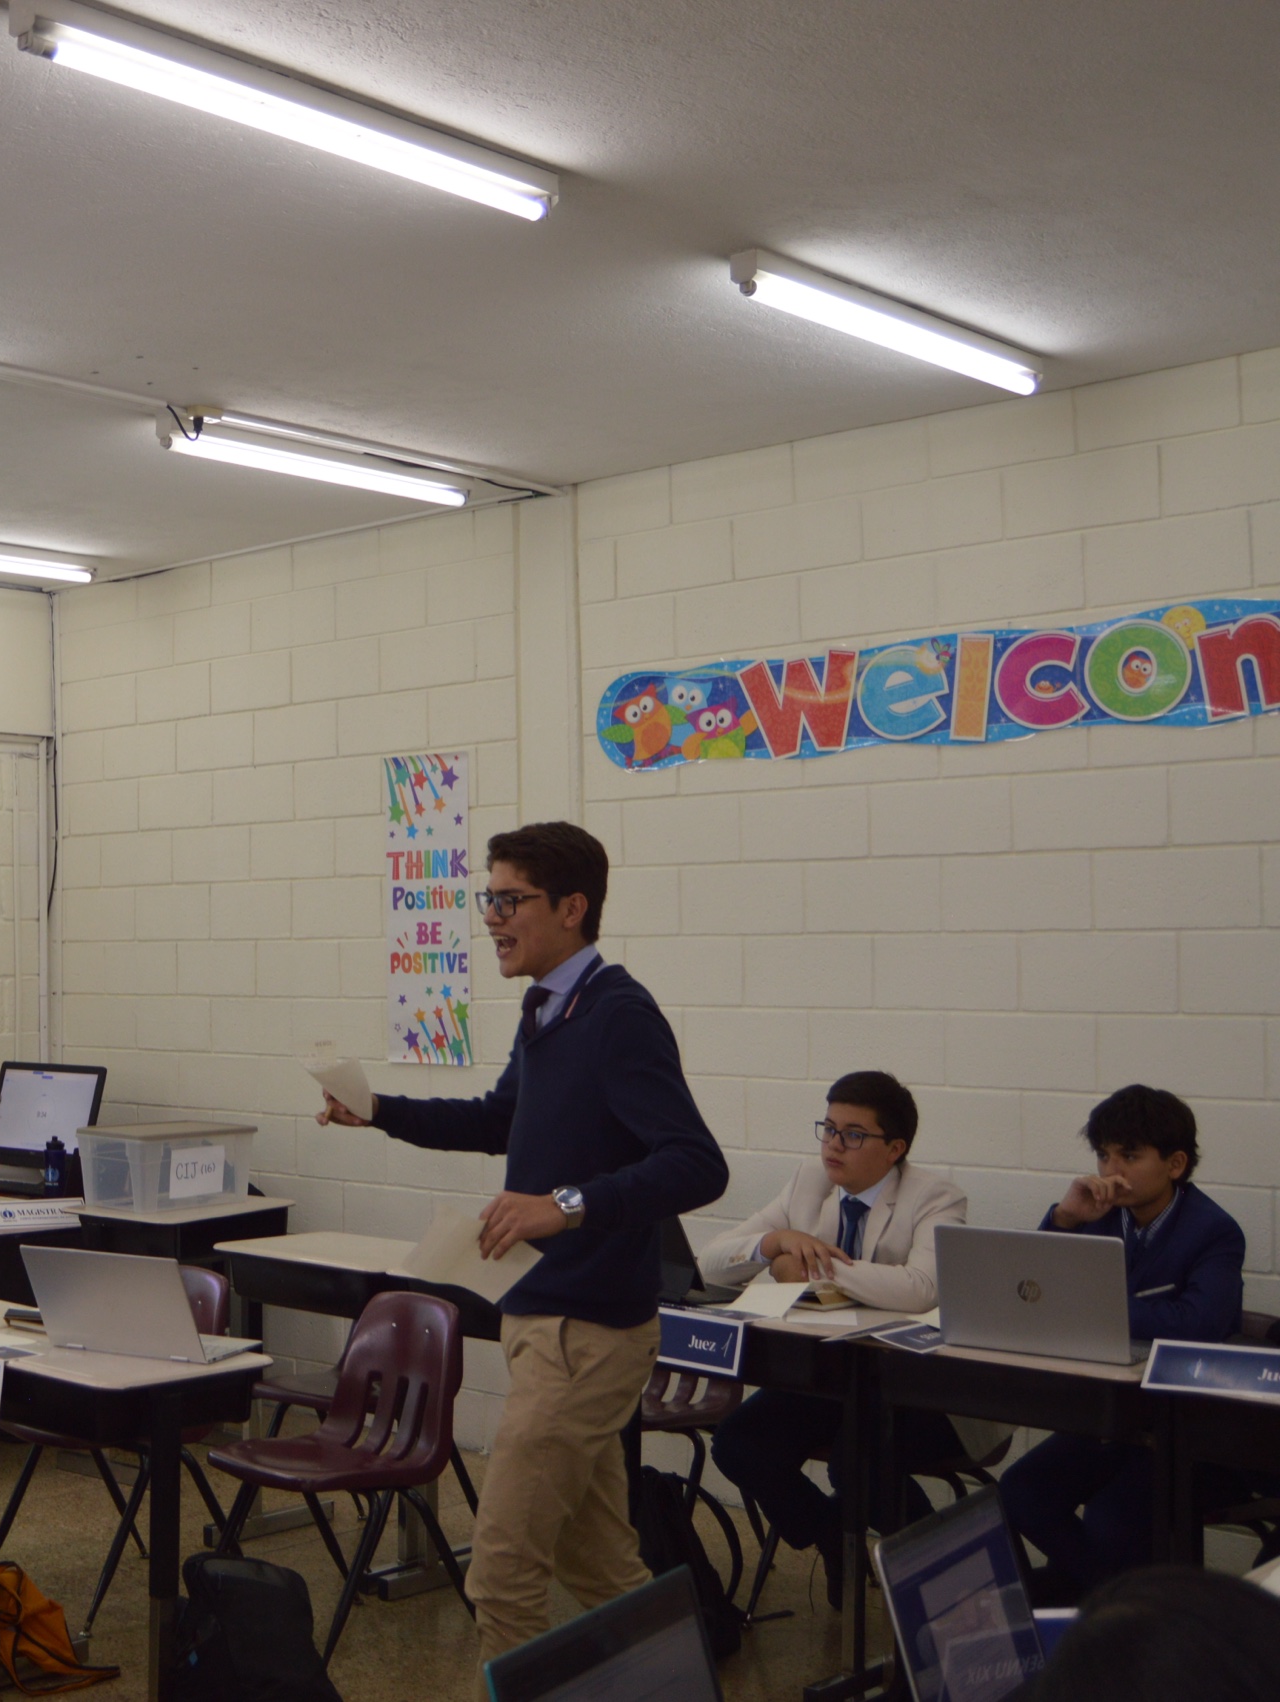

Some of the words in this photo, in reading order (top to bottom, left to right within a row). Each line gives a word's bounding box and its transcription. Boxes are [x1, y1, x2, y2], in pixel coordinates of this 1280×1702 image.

[386, 849, 468, 880] THINK
[392, 885, 466, 910] Positive
[416, 922, 442, 945] BE
[390, 951, 468, 974] POSITIVE
[176, 1162, 198, 1180] CIJ
[688, 1334, 716, 1352] Juez
